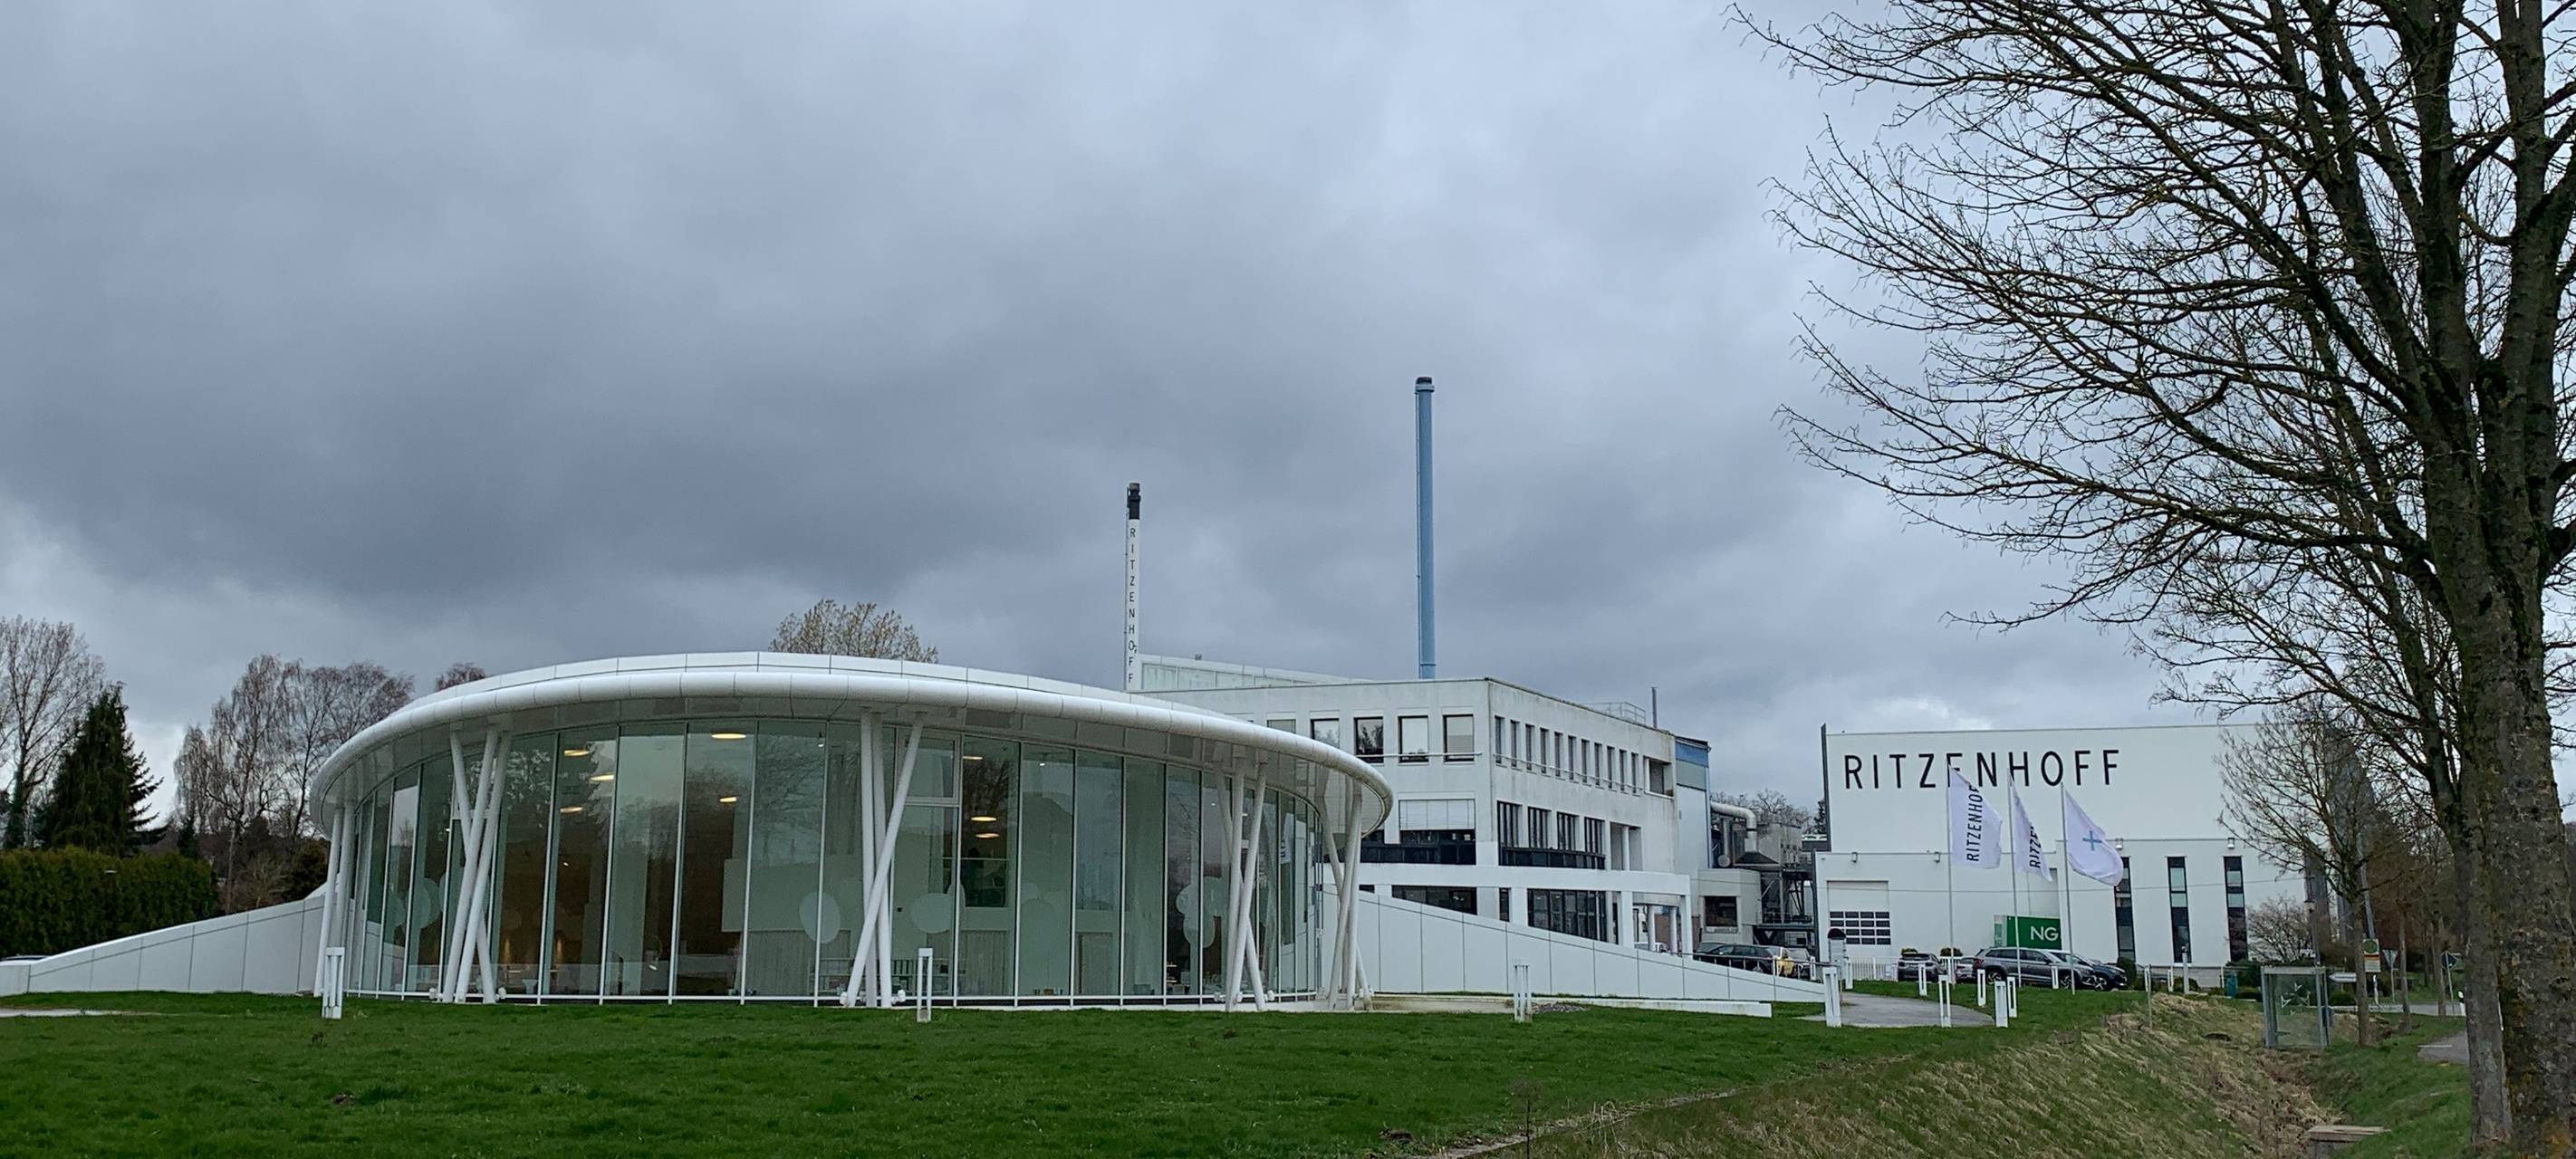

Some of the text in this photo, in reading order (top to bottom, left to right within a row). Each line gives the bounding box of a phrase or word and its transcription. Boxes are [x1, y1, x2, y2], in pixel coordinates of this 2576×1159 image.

[1128, 527, 1137, 683] RITZENHOFF
[1844, 750, 2119, 790] RITZENHOFF
[2030, 925, 2059, 942] NG
